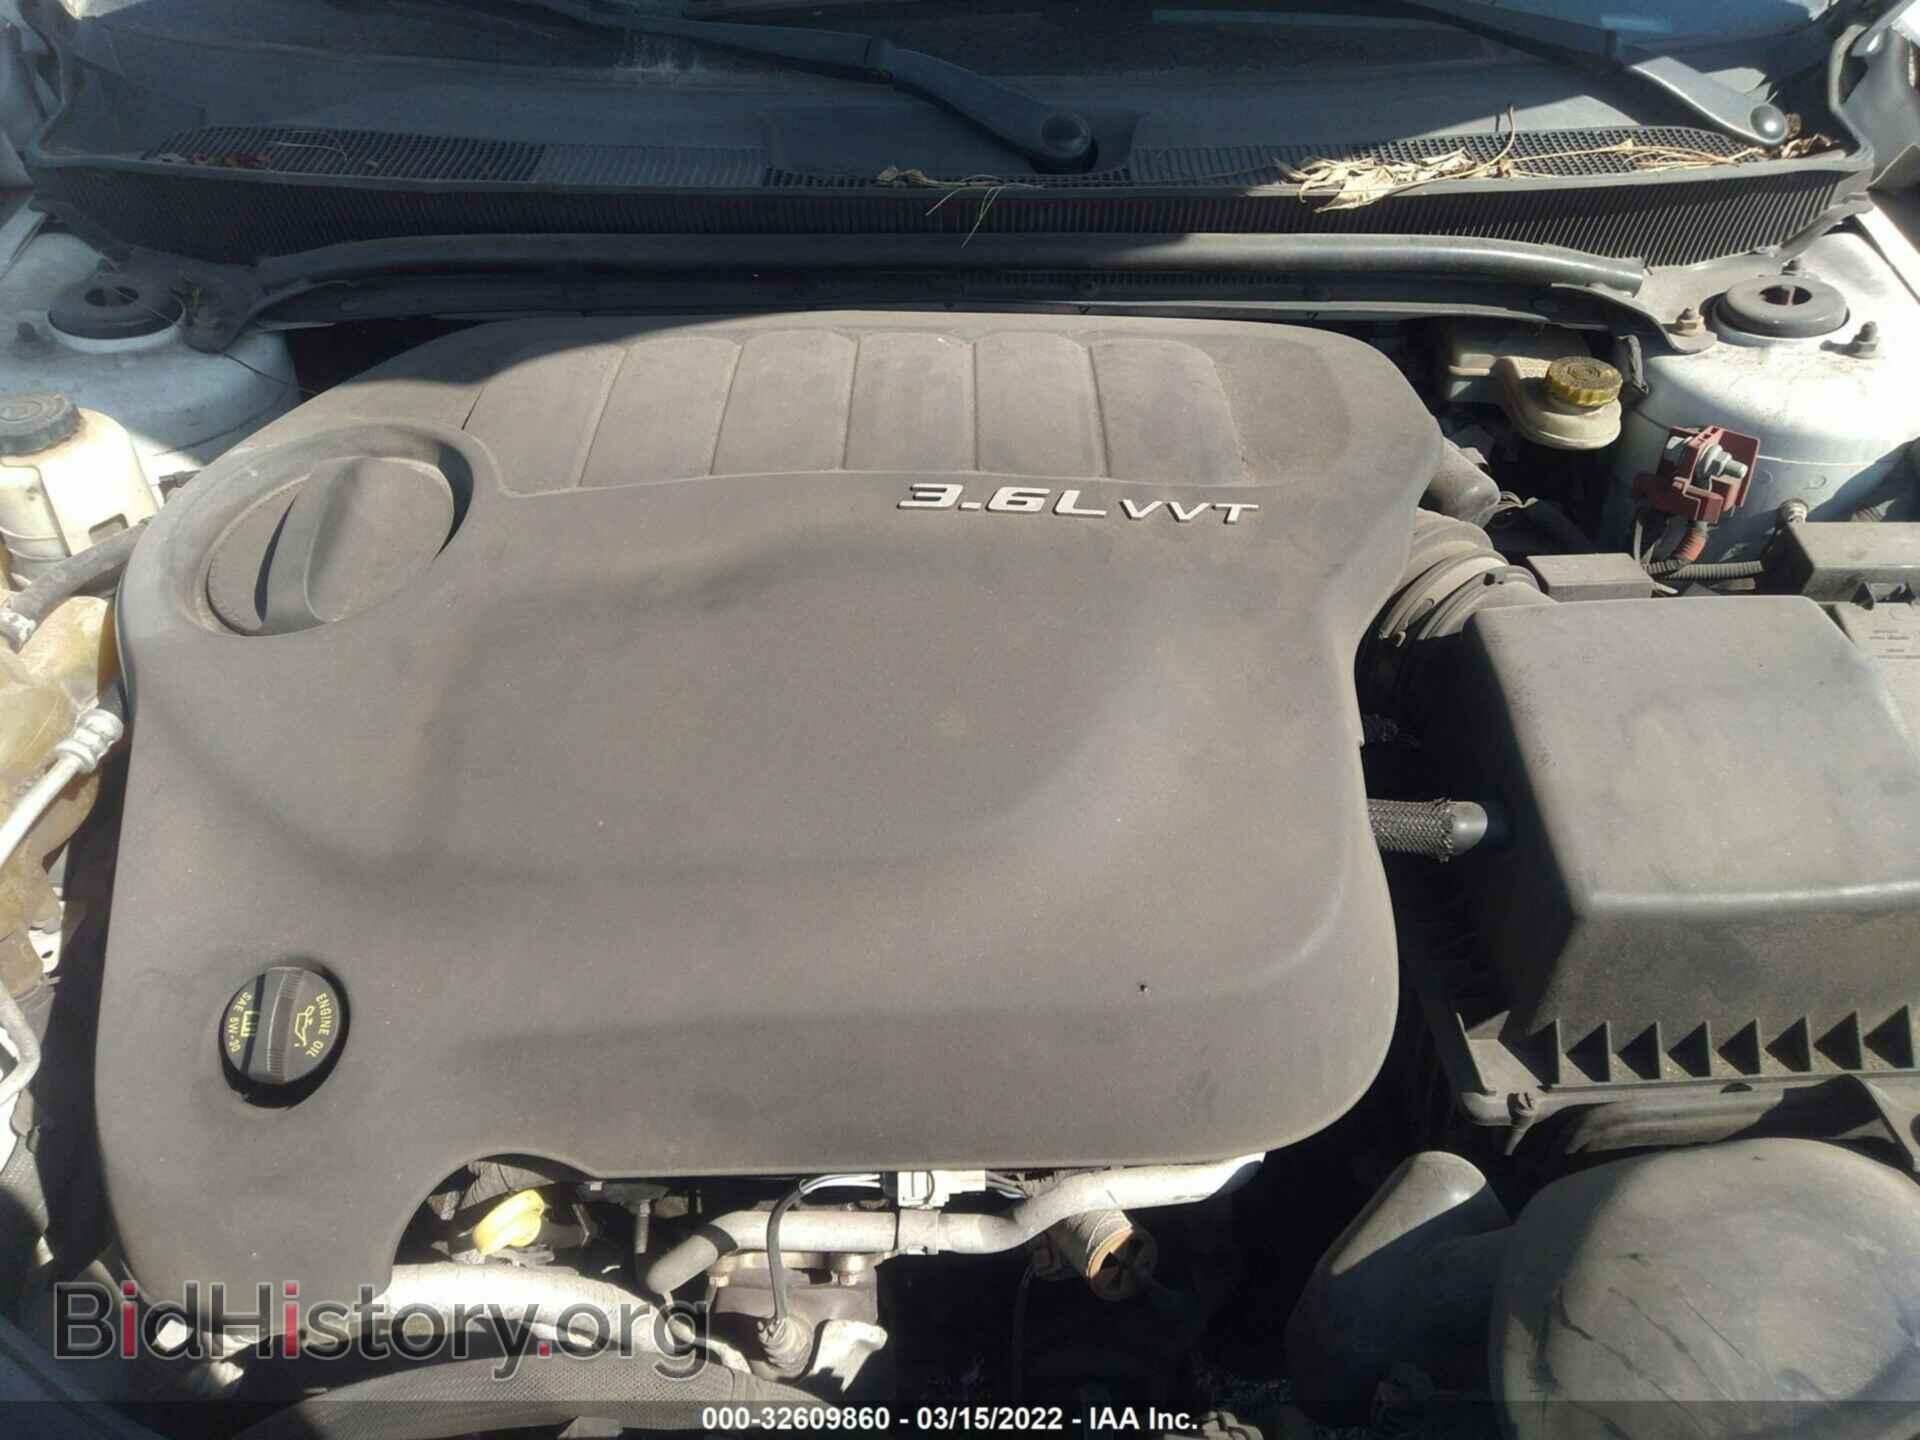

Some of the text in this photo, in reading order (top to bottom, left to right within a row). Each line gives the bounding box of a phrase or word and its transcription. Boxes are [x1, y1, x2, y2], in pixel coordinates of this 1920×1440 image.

[897, 483, 1259, 524] 3.6L VVT
[233, 991, 252, 1012] SAE
[305, 992, 332, 1057] ENGINE OIL
